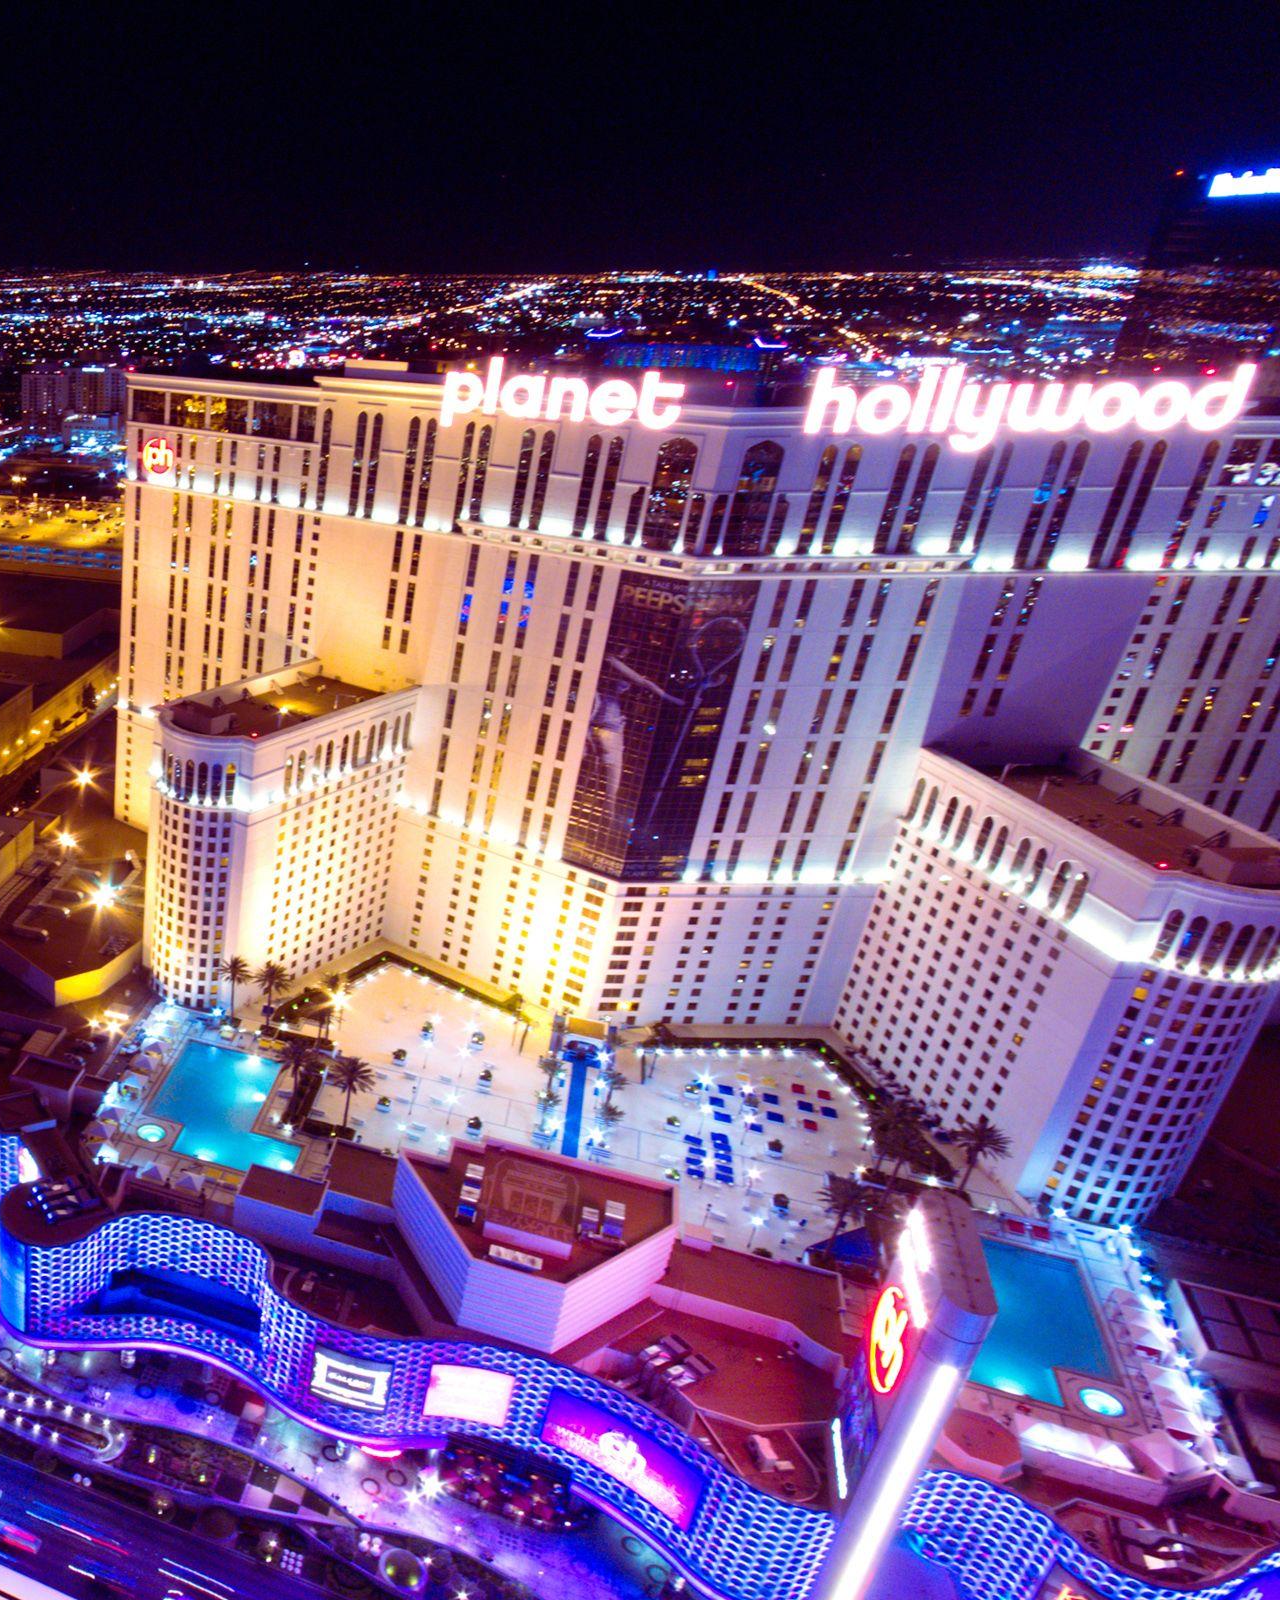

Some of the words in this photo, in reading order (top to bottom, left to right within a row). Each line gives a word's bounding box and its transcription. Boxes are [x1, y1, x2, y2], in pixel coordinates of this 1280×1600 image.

[440, 356, 686, 430] planet
[803, 363, 1256, 453] hollywood
[621, 584, 757, 616] PEEPSOW
